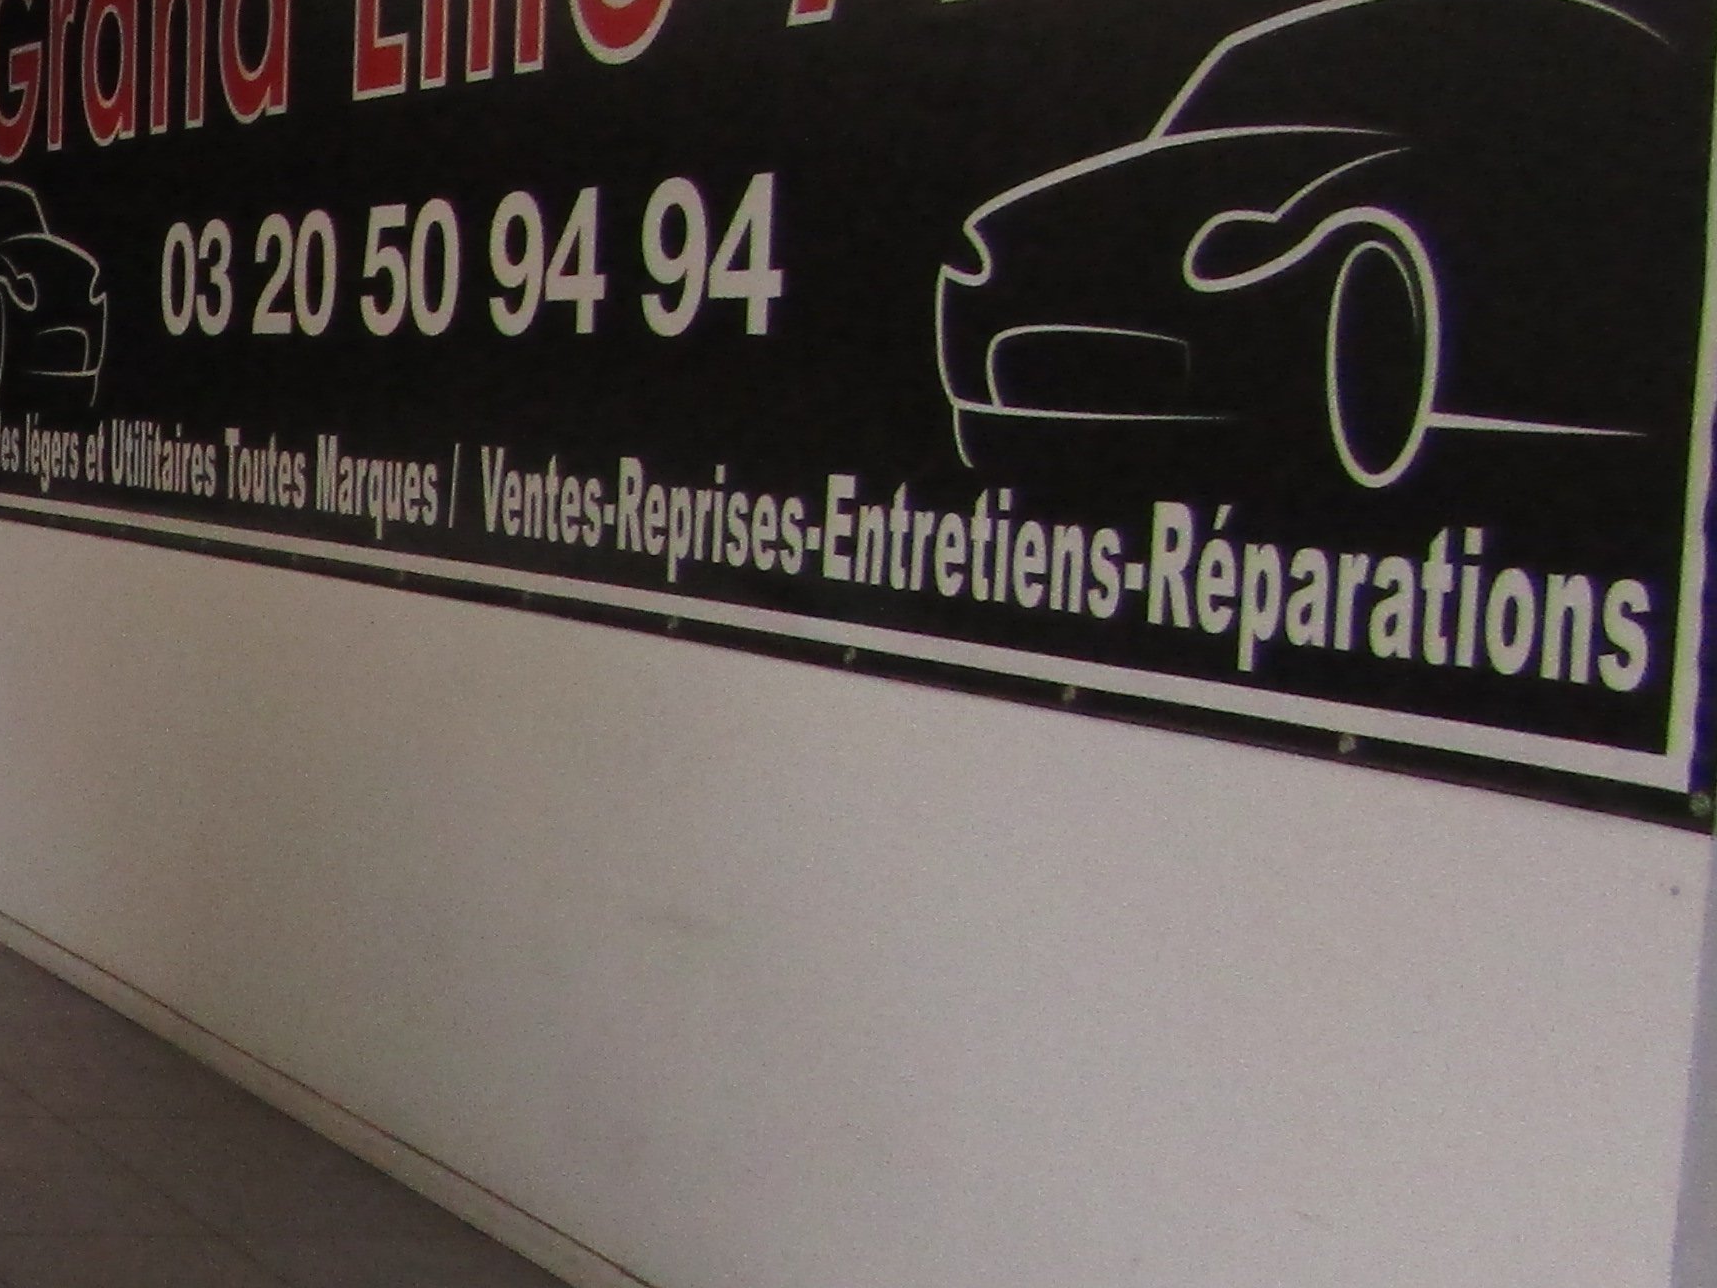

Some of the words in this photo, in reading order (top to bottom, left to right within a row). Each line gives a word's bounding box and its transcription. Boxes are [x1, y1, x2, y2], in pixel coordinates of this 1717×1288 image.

[162, 218, 233, 336] 03
[252, 209, 336, 336] 20
[360, 198, 461, 337] 50
[489, 187, 606, 337] 94
[642, 173, 784, 337] 94
[25, 412, 79, 493] légers
[86, 420, 105, 483] et
[112, 418, 216, 498] Utilitaires
[225, 427, 305, 509] Toutes
[316, 434, 437, 540] Marques
